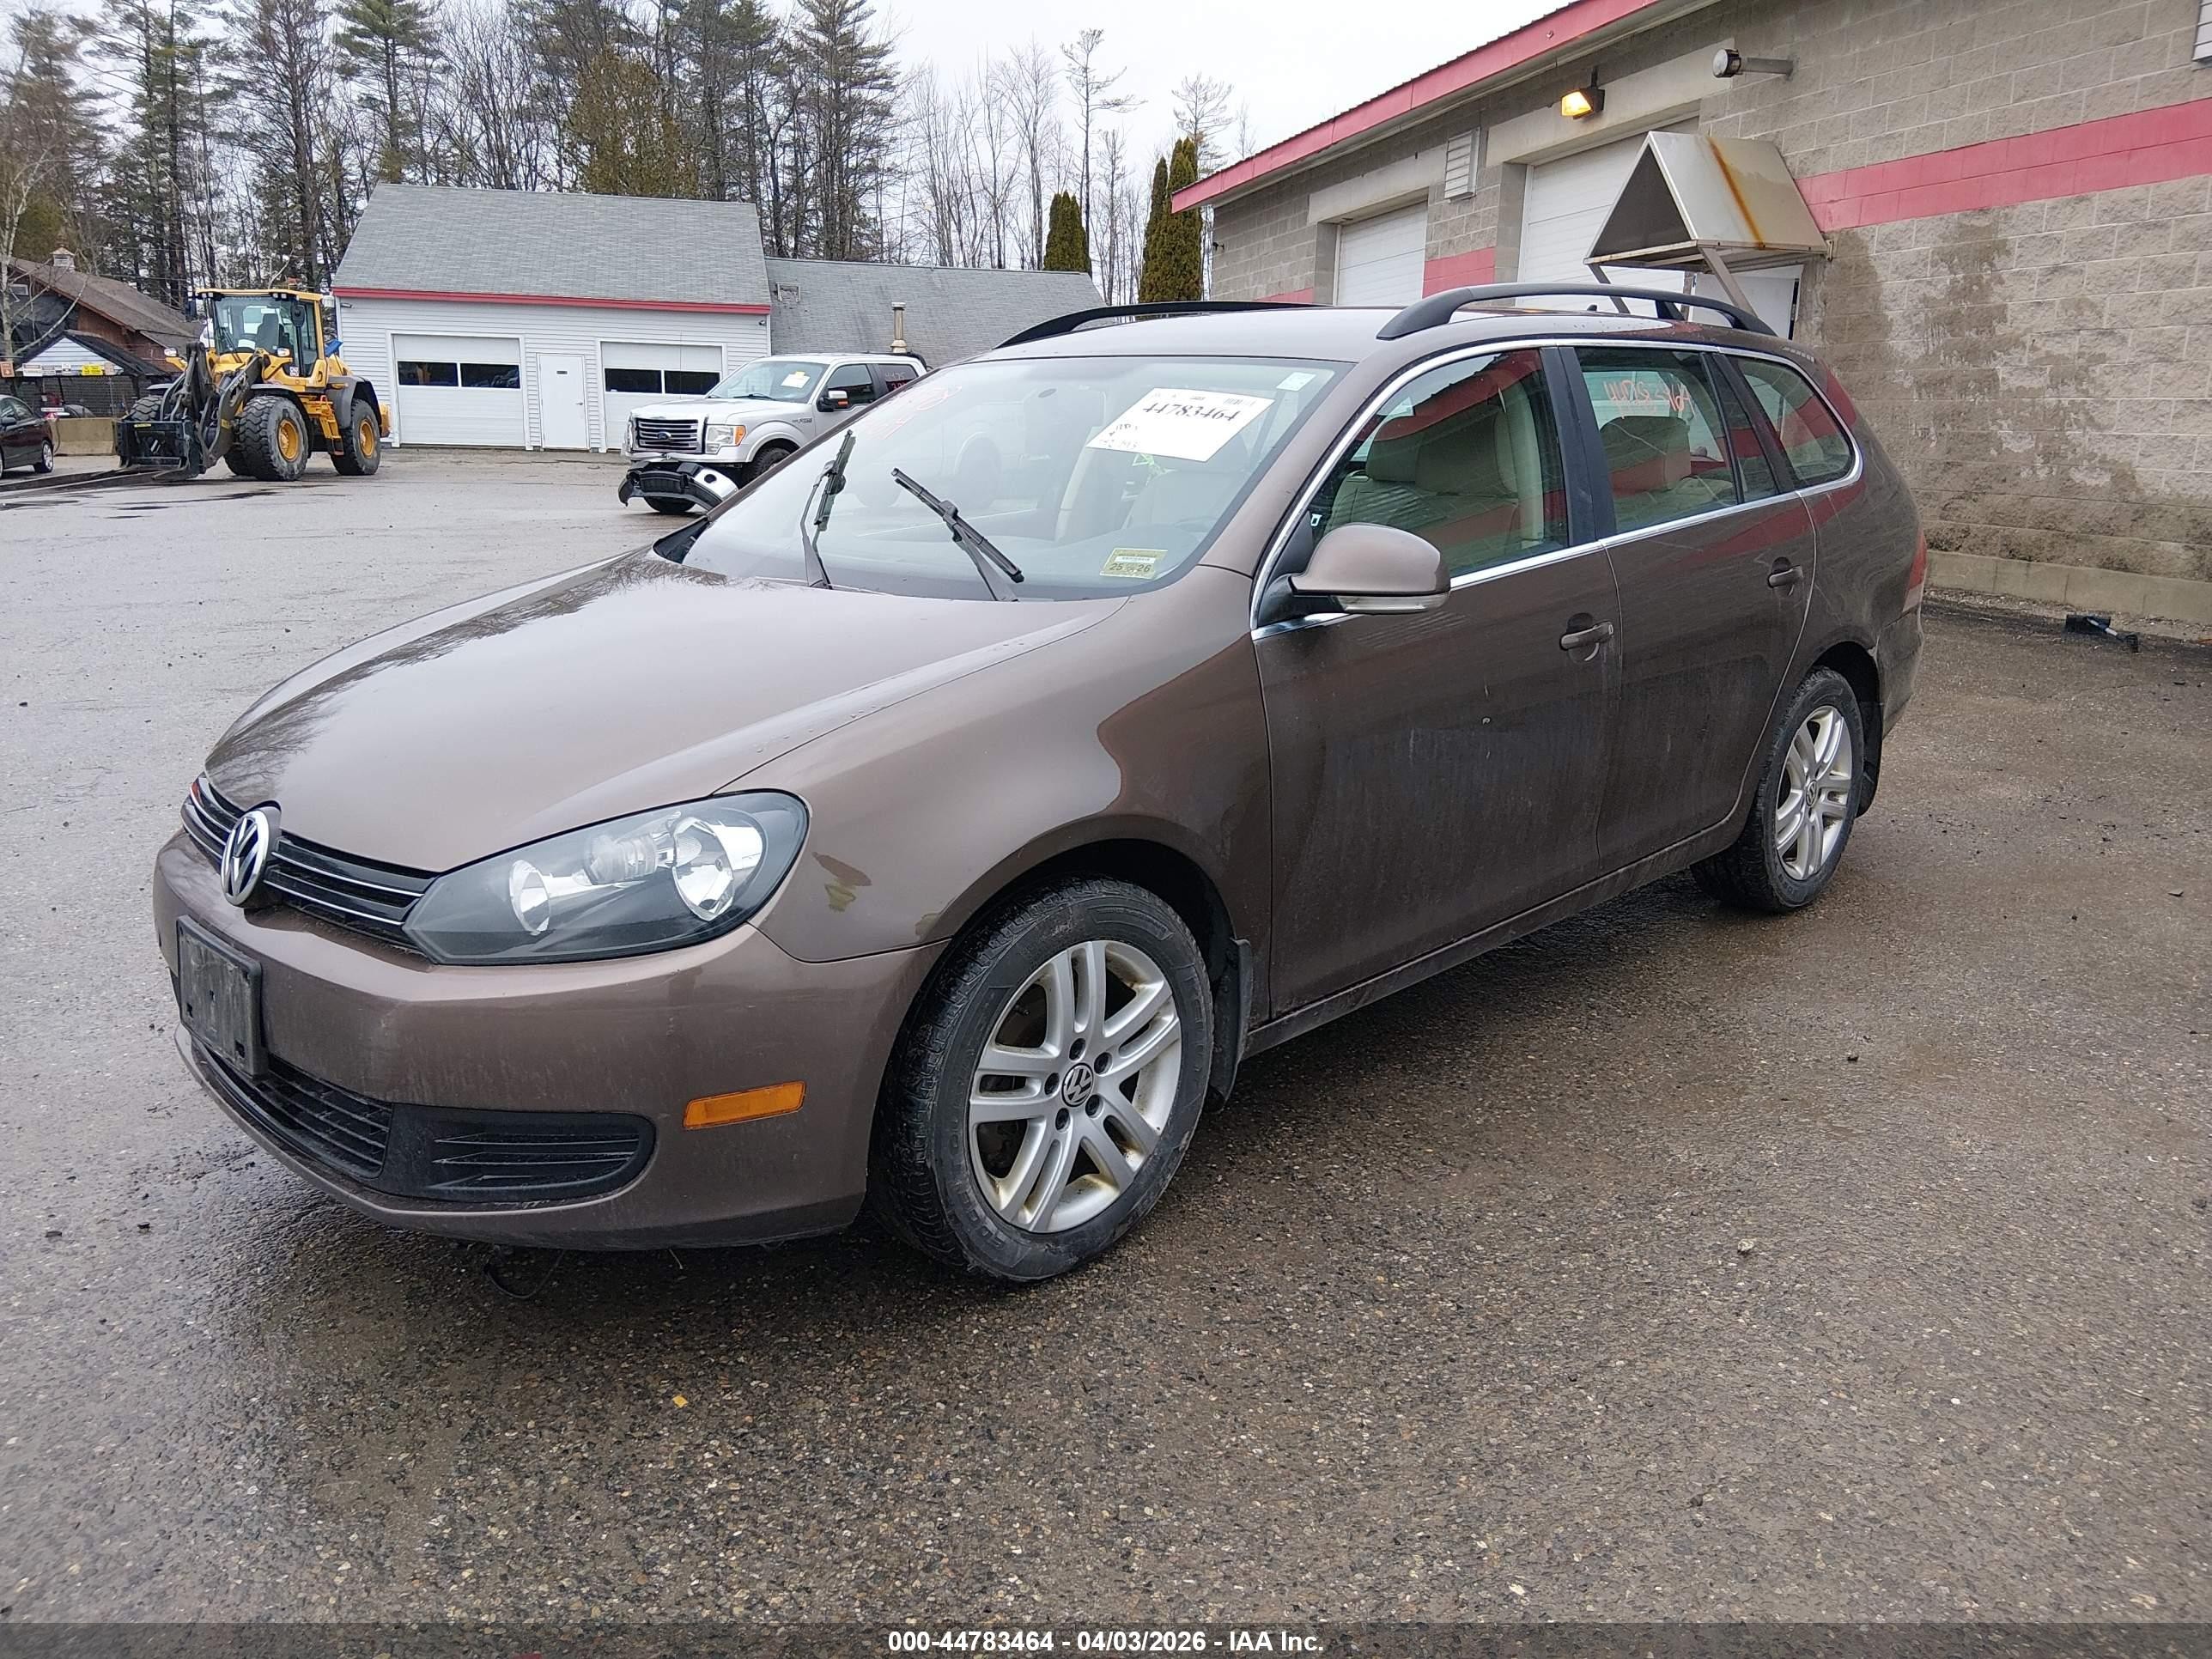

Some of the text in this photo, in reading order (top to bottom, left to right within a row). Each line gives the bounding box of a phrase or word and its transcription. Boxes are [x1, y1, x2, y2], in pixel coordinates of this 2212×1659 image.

[1142, 402, 1242, 422] 44783464
[1109, 562, 1124, 571] 25
[1136, 563, 1152, 573] 26
